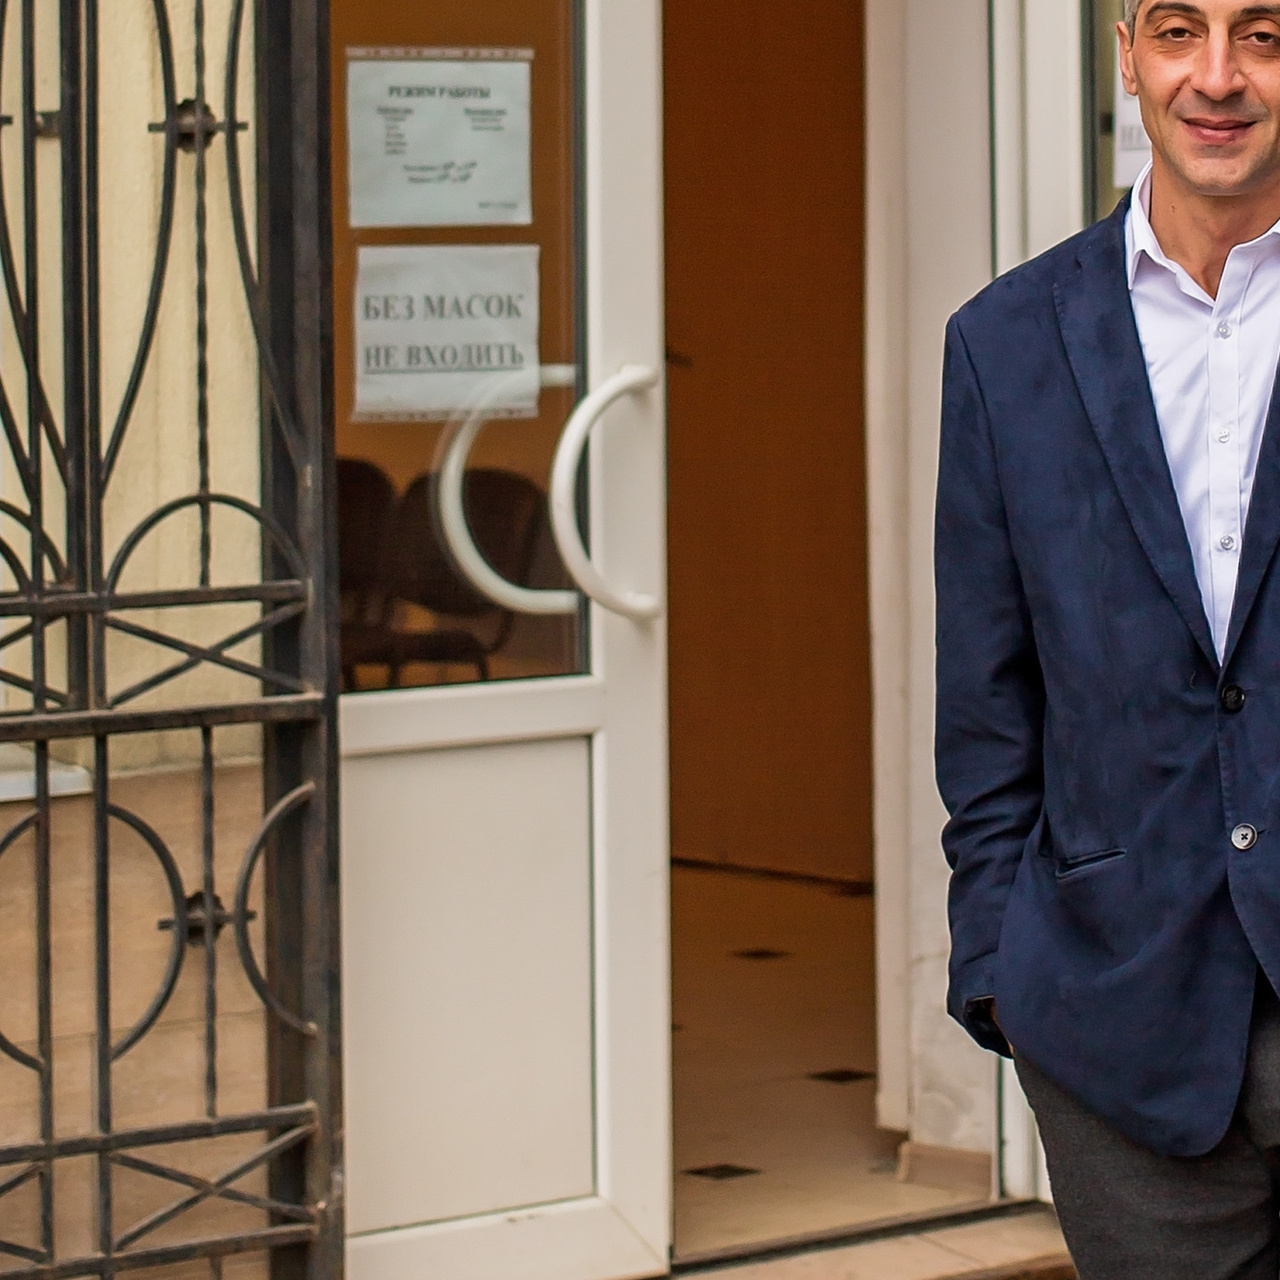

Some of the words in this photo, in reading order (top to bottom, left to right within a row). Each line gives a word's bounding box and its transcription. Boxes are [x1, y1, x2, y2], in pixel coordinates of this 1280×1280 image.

[363, 294, 415, 320] БЕЗ
[423, 293, 524, 319] МАСОК
[365, 344, 397, 369] НЕ
[407, 342, 524, 367] ВХОДИТЬ
